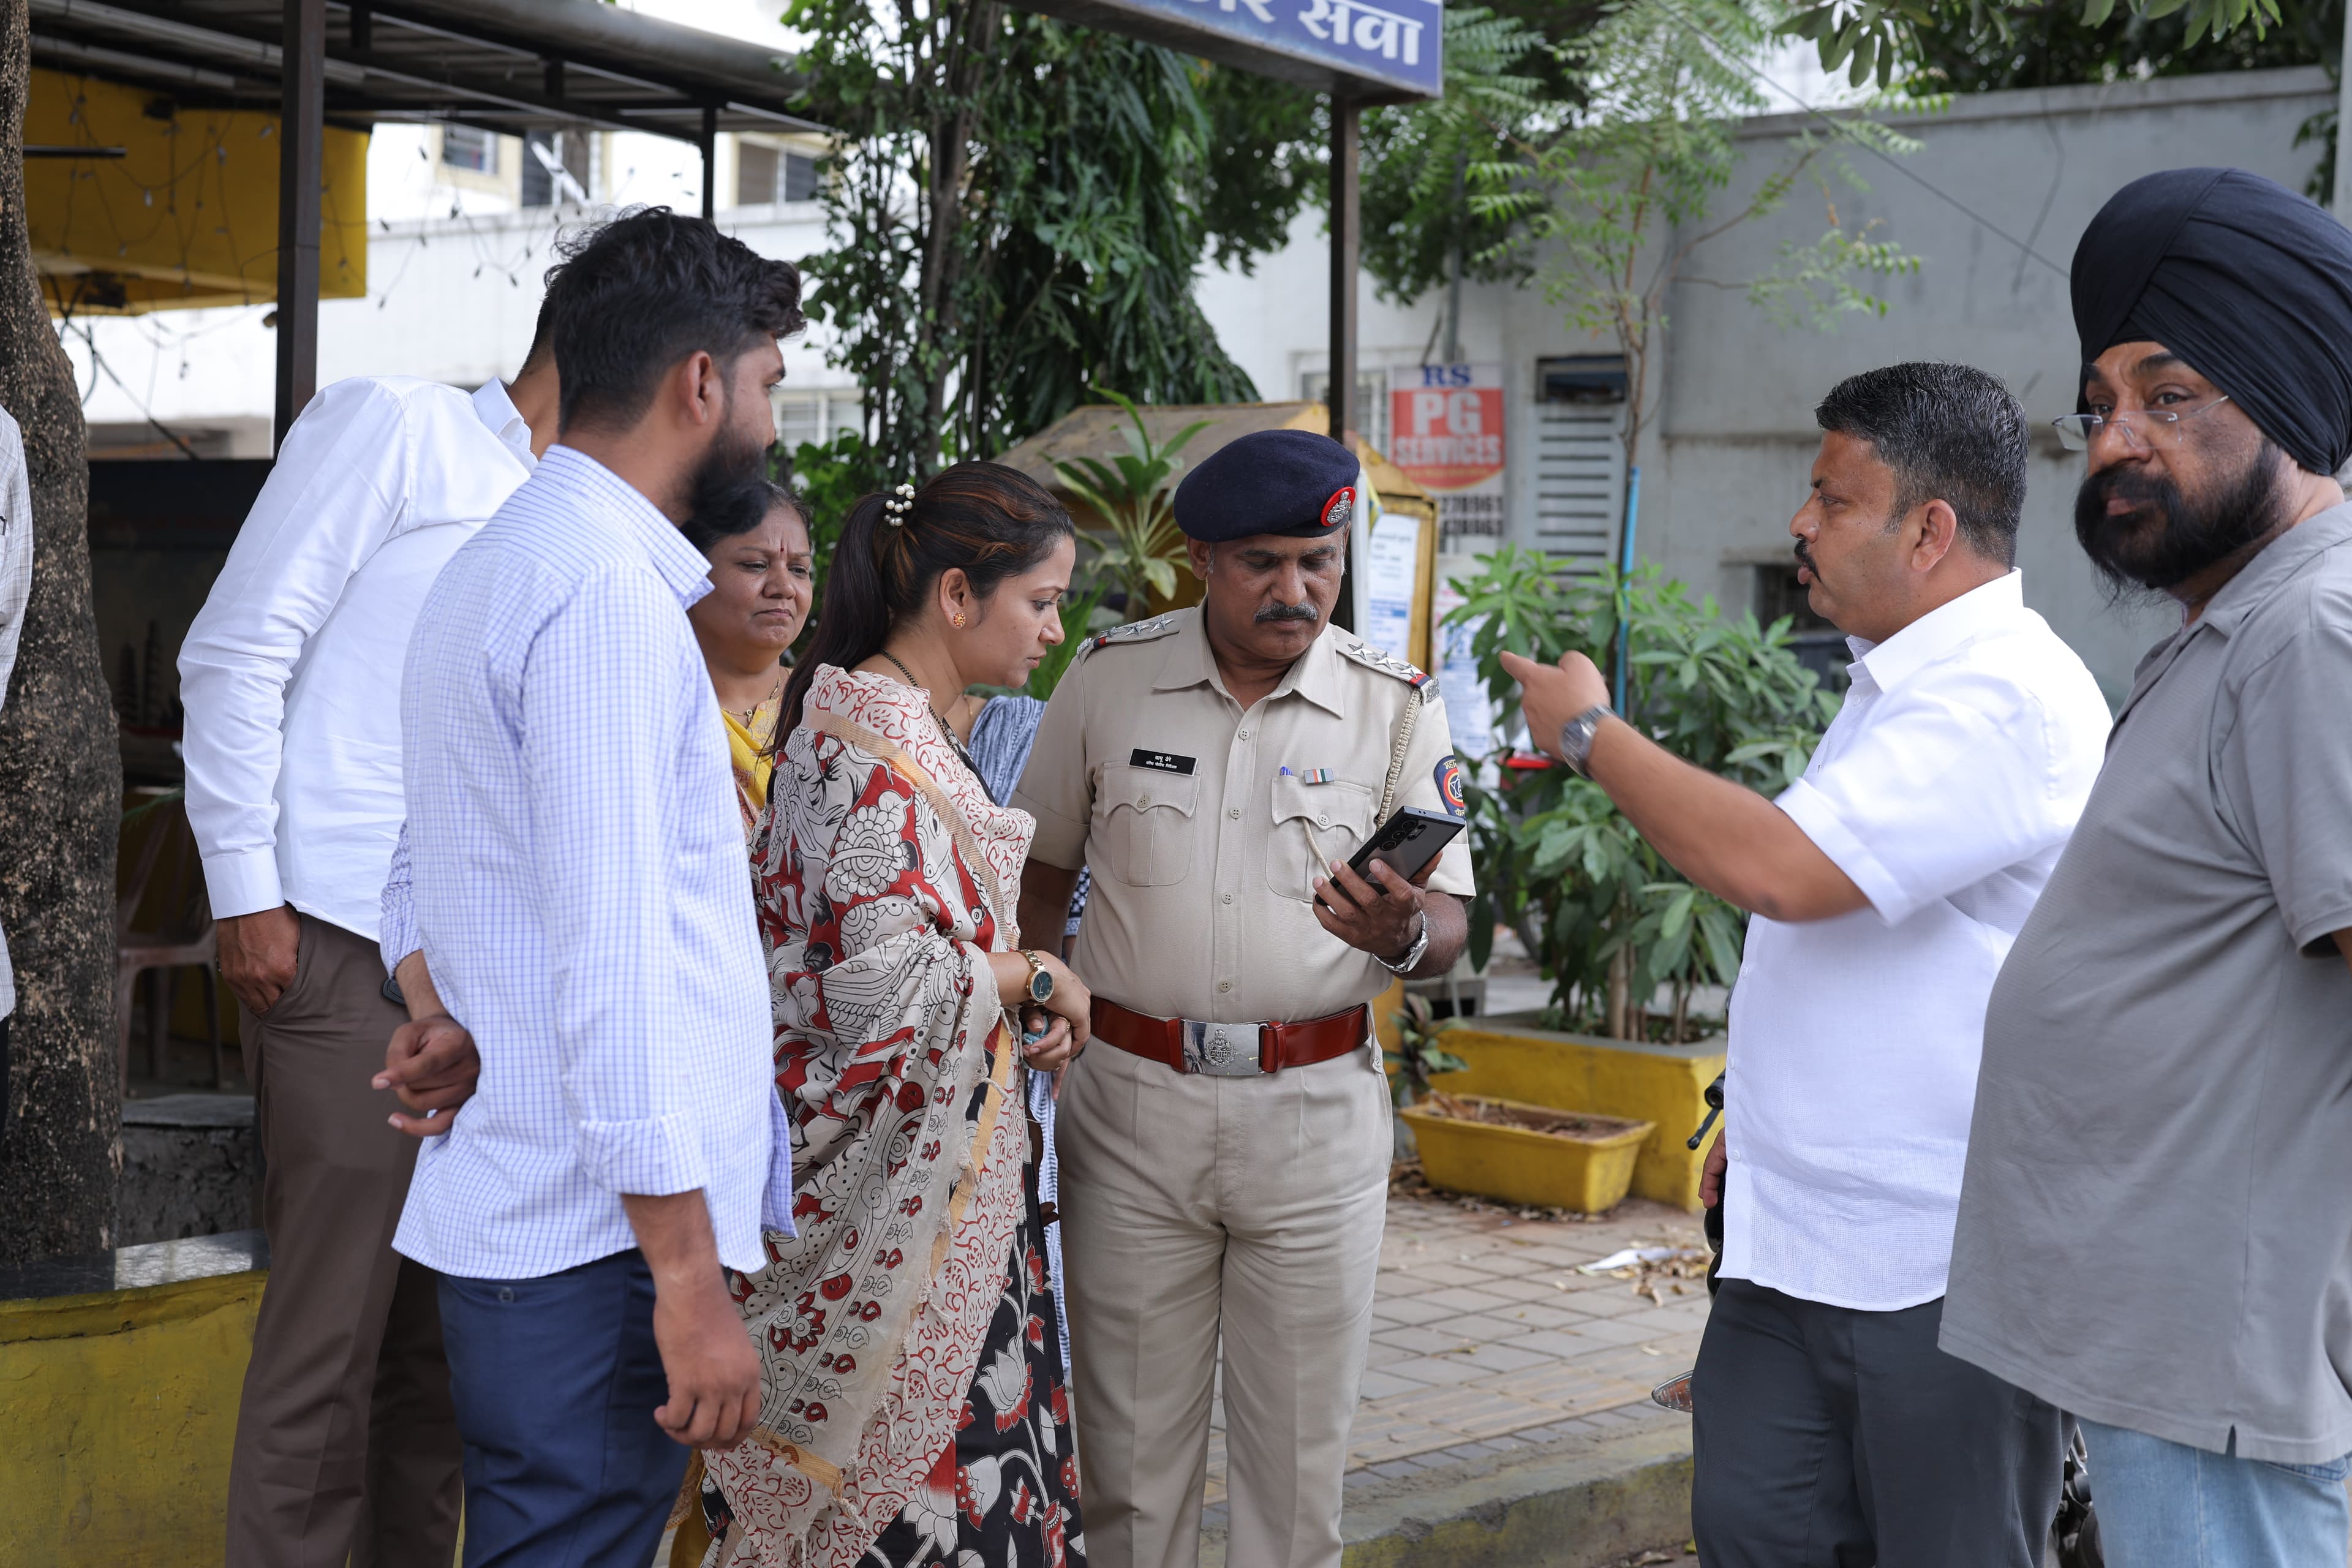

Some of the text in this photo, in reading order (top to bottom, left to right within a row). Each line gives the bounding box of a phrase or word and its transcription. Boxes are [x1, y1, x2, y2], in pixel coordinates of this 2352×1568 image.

[1422, 365, 1471, 387] RS
[1412, 391, 1482, 435] PG
[1444, 760, 1457, 769] महा
